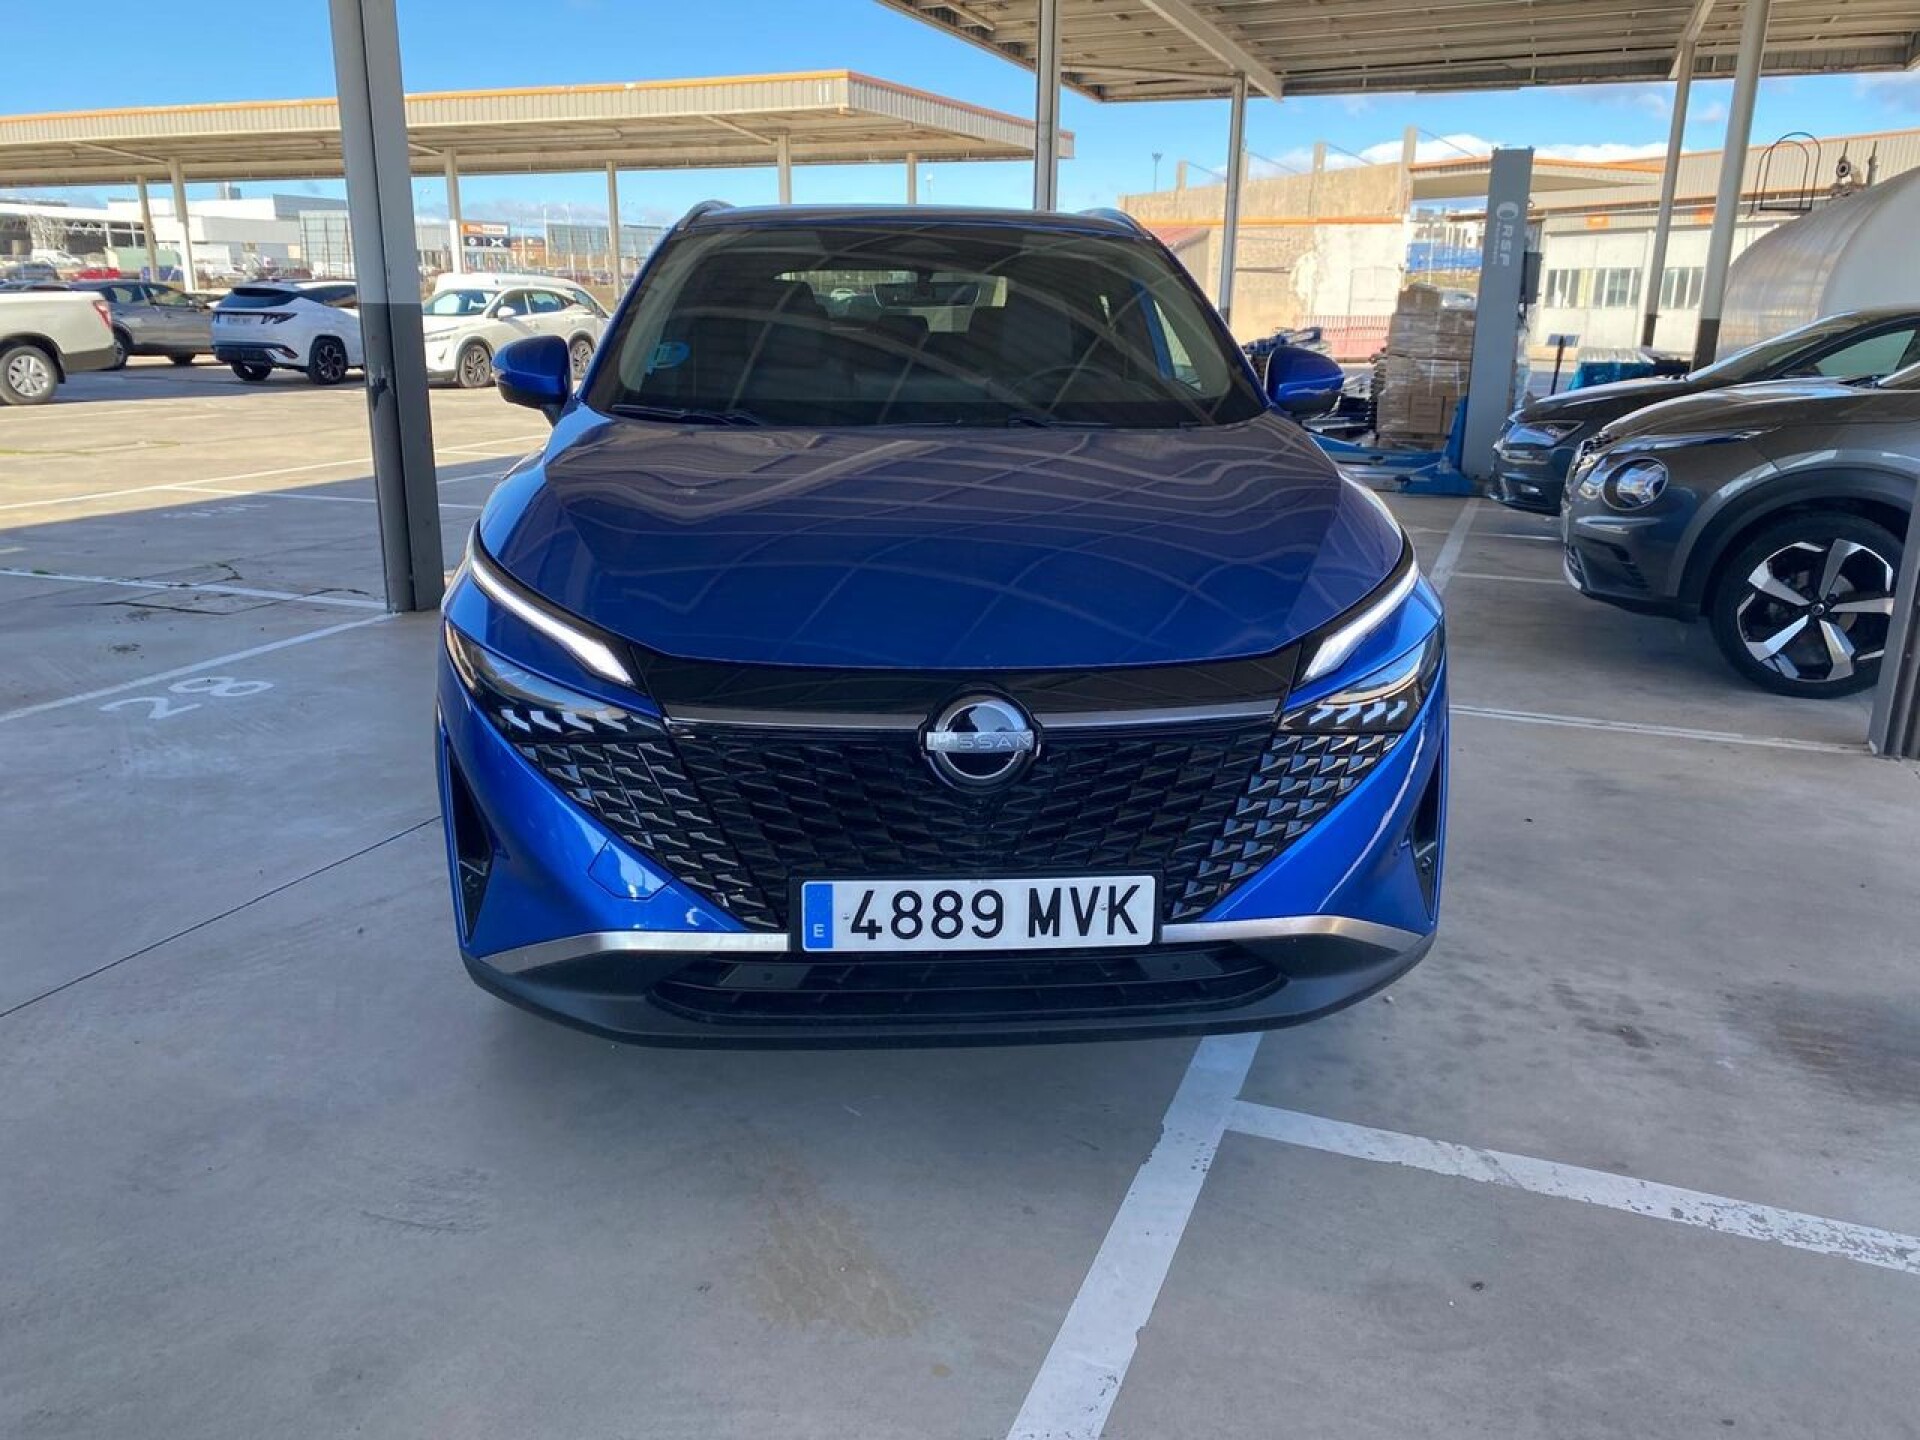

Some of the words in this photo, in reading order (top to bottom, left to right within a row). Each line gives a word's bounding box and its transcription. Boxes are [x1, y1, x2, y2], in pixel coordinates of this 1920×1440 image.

[99, 676, 274, 719] 28
[812, 924, 825, 938] E
[850, 890, 1004, 940] 4889
[1028, 885, 1141, 938] MVK
